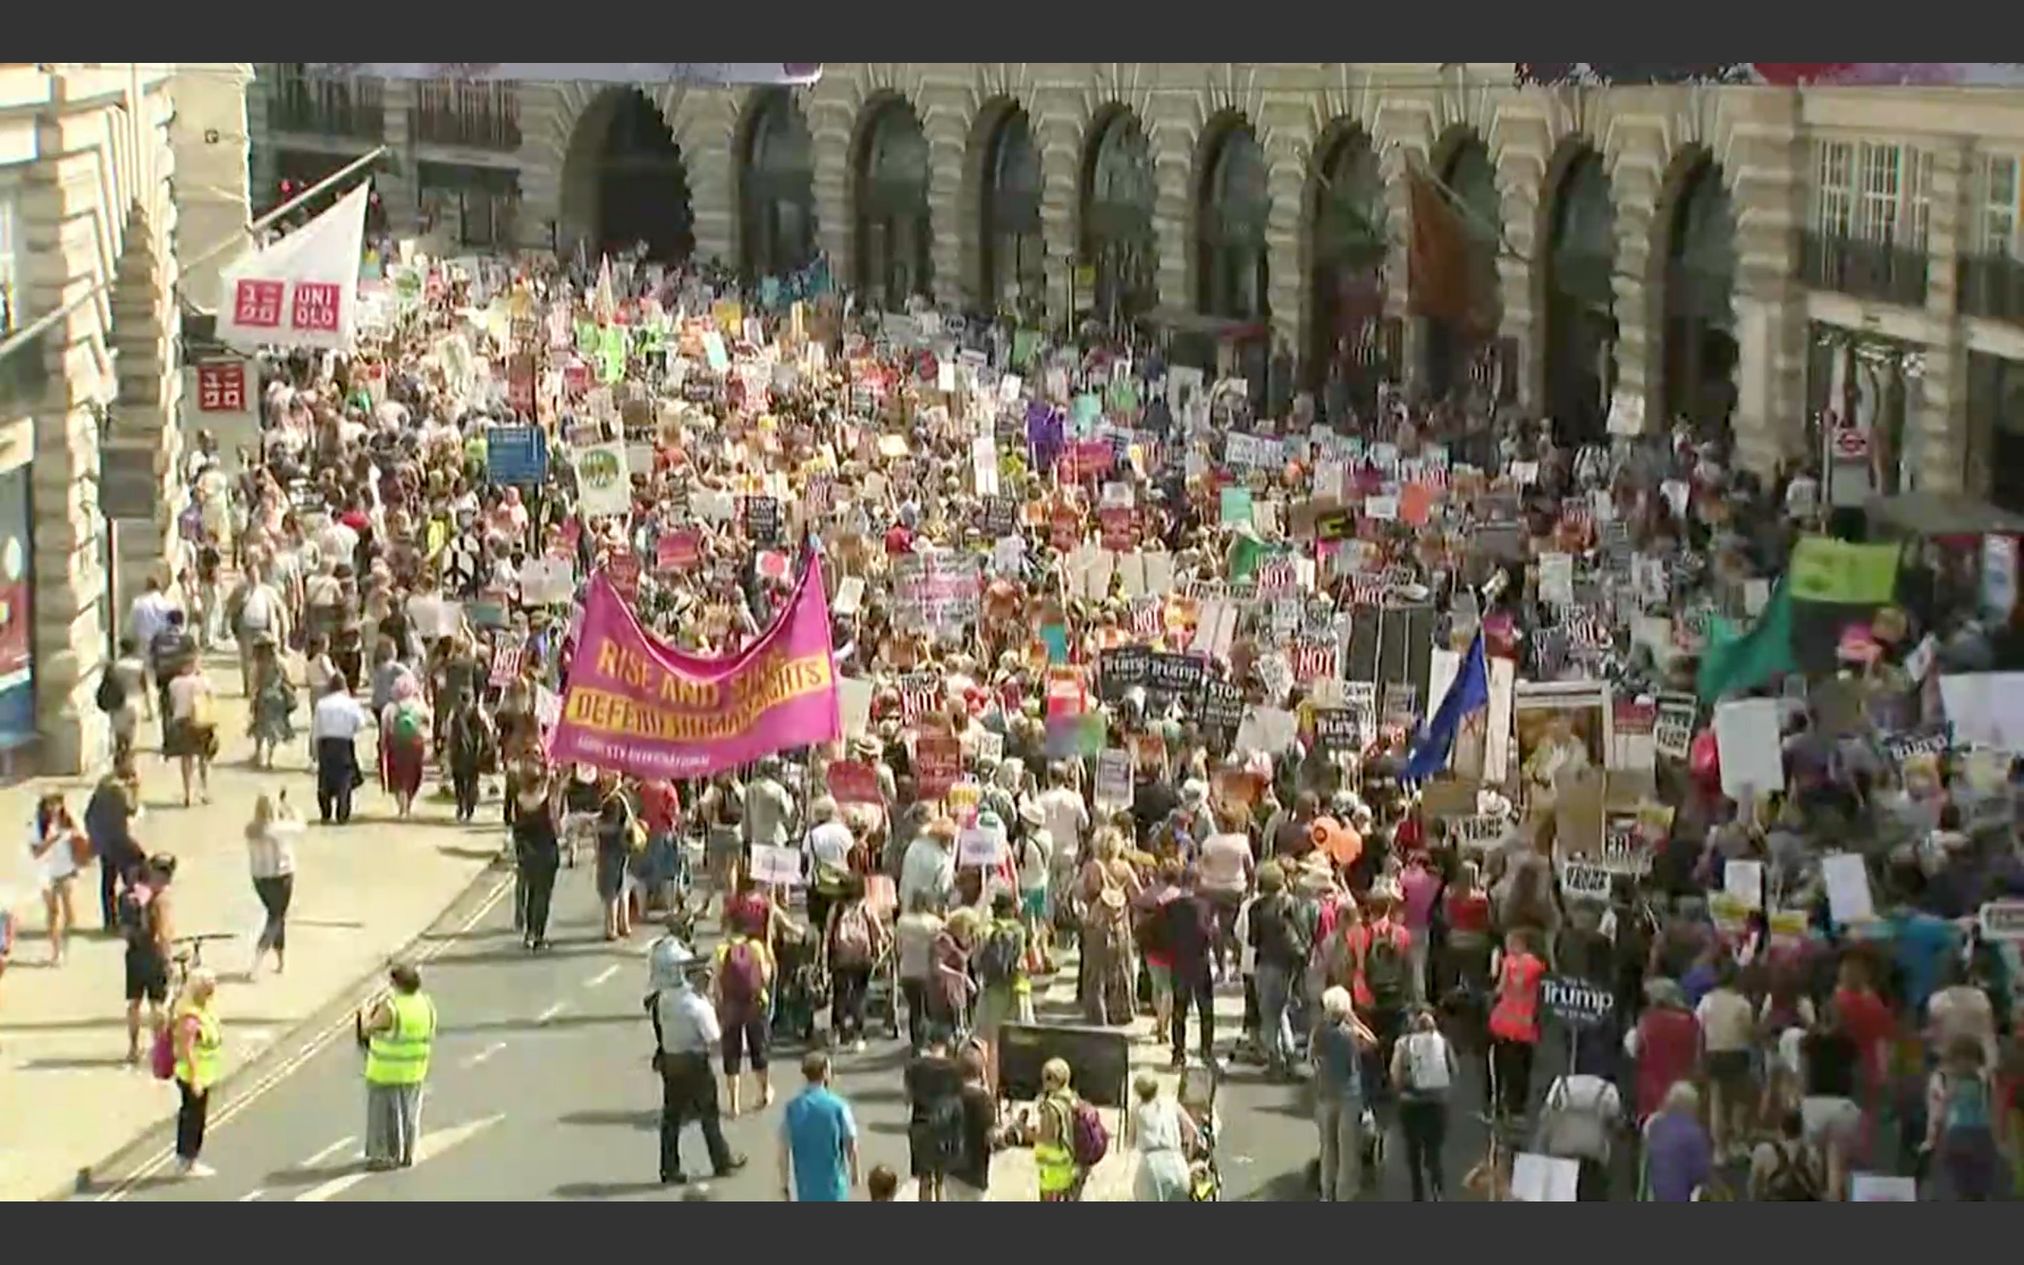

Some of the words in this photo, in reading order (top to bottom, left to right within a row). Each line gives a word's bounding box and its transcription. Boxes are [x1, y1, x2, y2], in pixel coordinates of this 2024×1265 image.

[297, 286, 332, 305] UNI
[596, 636, 652, 687] RISE
[660, 677, 719, 708] AND
[1299, 647, 1334, 677] NOT
[1208, 680, 1243, 699] STOP
[1541, 980, 1614, 1016] Trump
